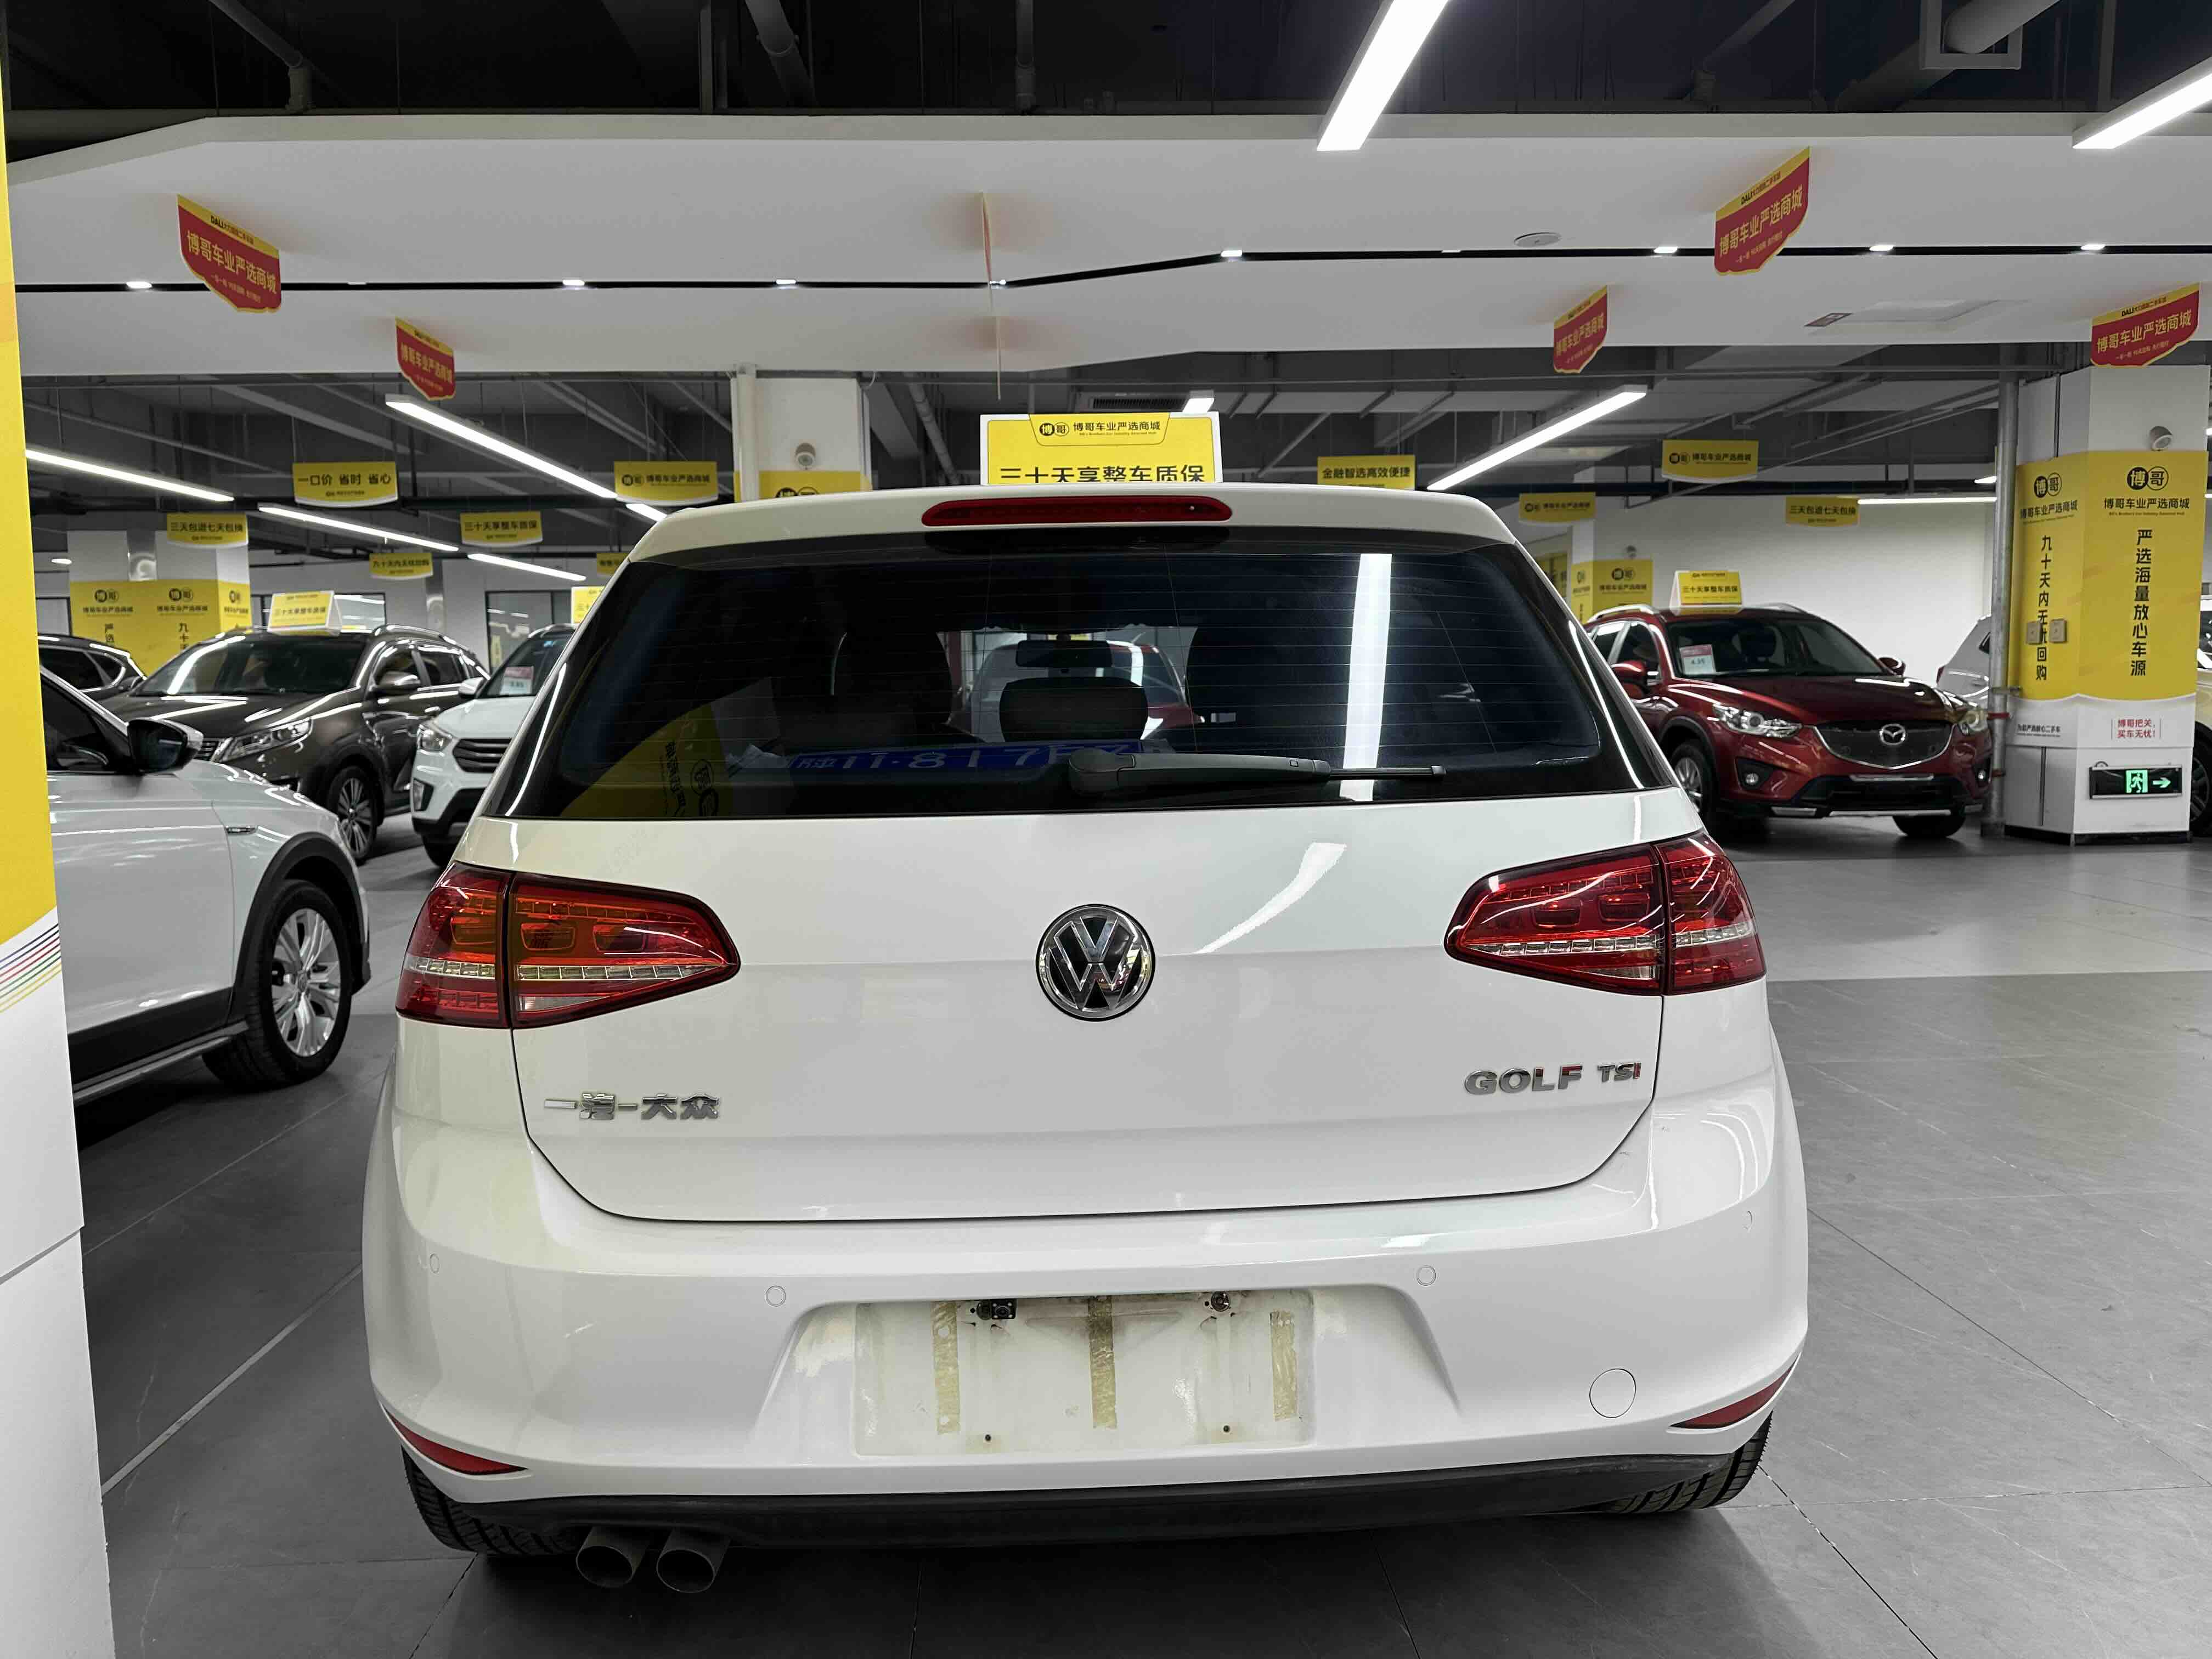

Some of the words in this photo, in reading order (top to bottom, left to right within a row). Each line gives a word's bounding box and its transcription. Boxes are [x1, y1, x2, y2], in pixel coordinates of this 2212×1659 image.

[1719, 184, 1804, 257] 博哥车业严选商城
[187, 230, 276, 294] 博哥车业严选商城
[2097, 308, 2192, 353] 博哥车业严选商城
[1073, 421, 1161, 431] 博哥车业严选商城
[298, 474, 332, 486] 一口价
[2034, 472, 2062, 498] 博哥
[2127, 466, 2169, 490] 博哥
[2020, 500, 2078, 519] 博哥车业严选商城
[2104, 498, 2190, 509] 博哥车业严选商城
[2130, 529, 2153, 676] 严选海量放心车源
[1464, 1064, 1583, 1095] GOLF
[1597, 1062, 1642, 1082] TSI
